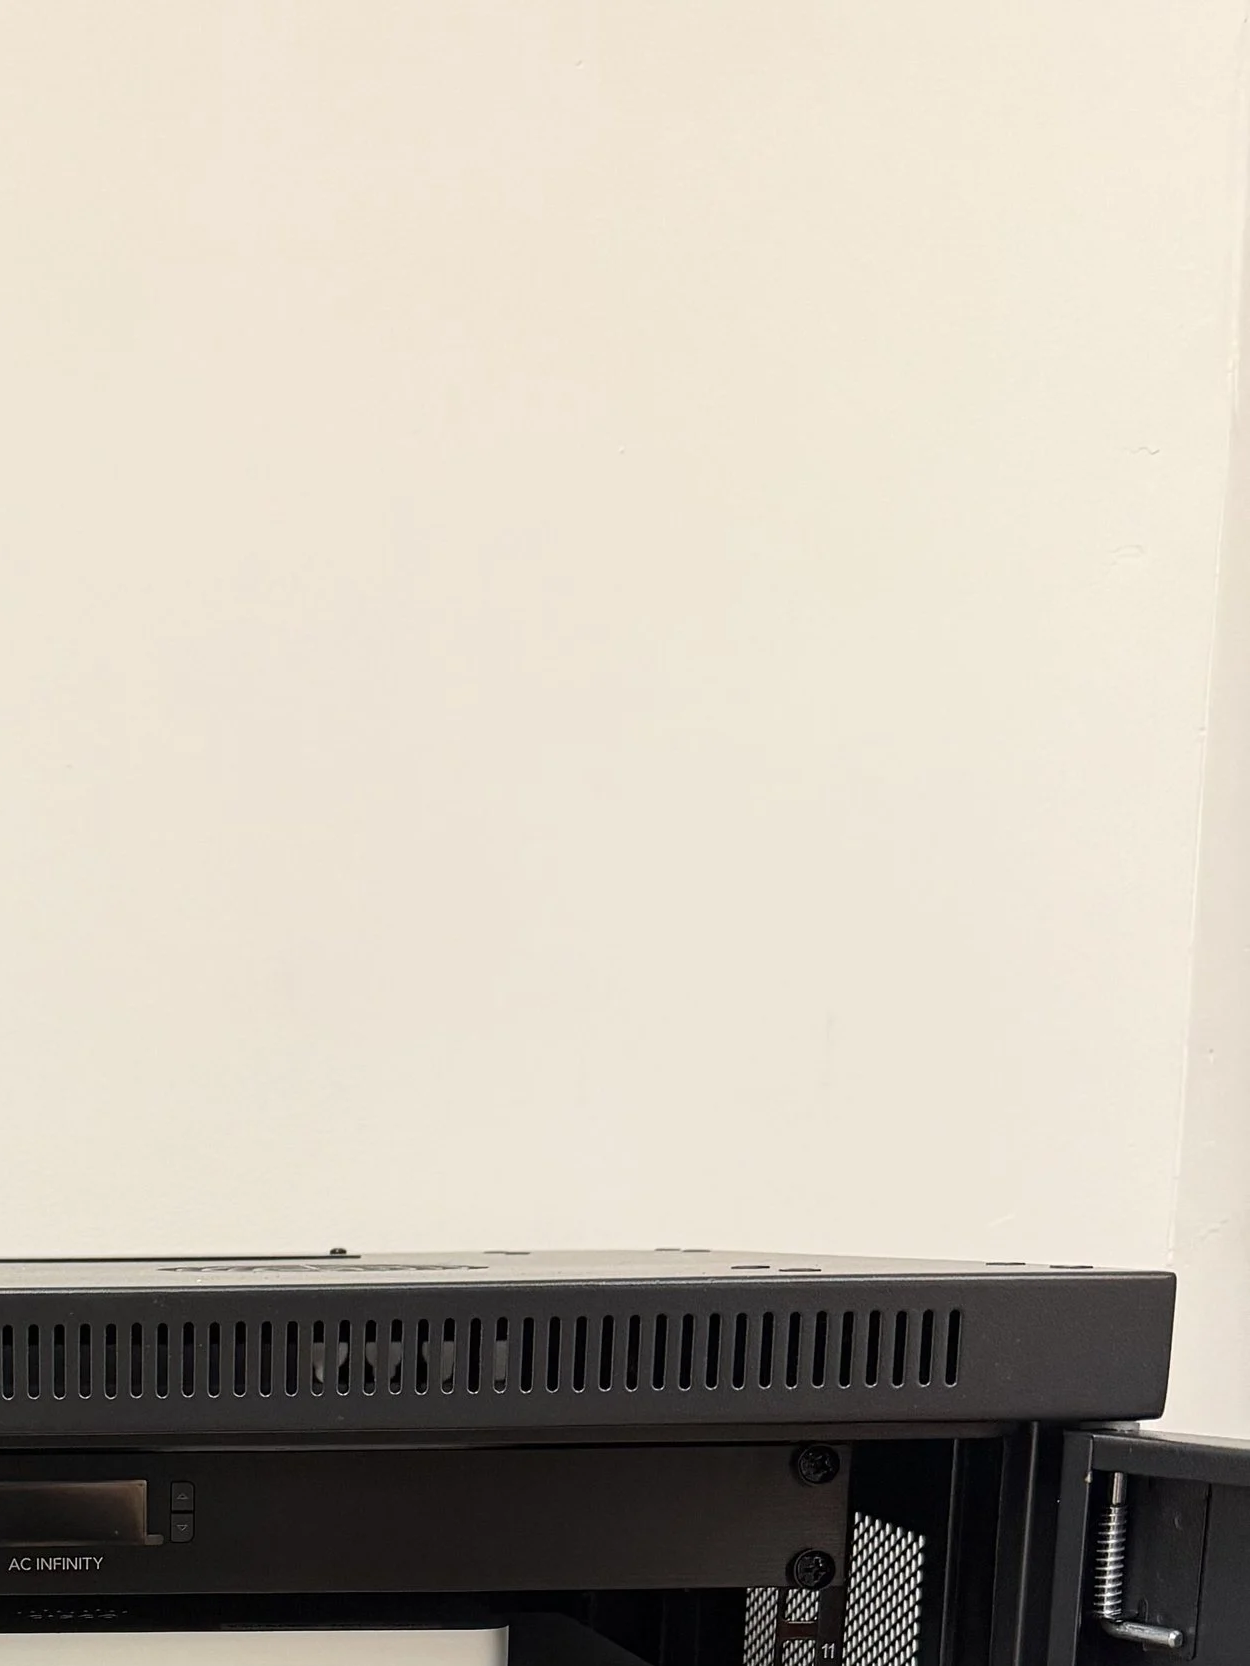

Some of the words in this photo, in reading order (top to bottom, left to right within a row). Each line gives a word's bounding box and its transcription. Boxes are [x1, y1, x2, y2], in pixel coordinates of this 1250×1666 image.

[9, 1558, 31, 1570] AC
[37, 1557, 102, 1570] INFINITY
[822, 1644, 834, 1658] 11
